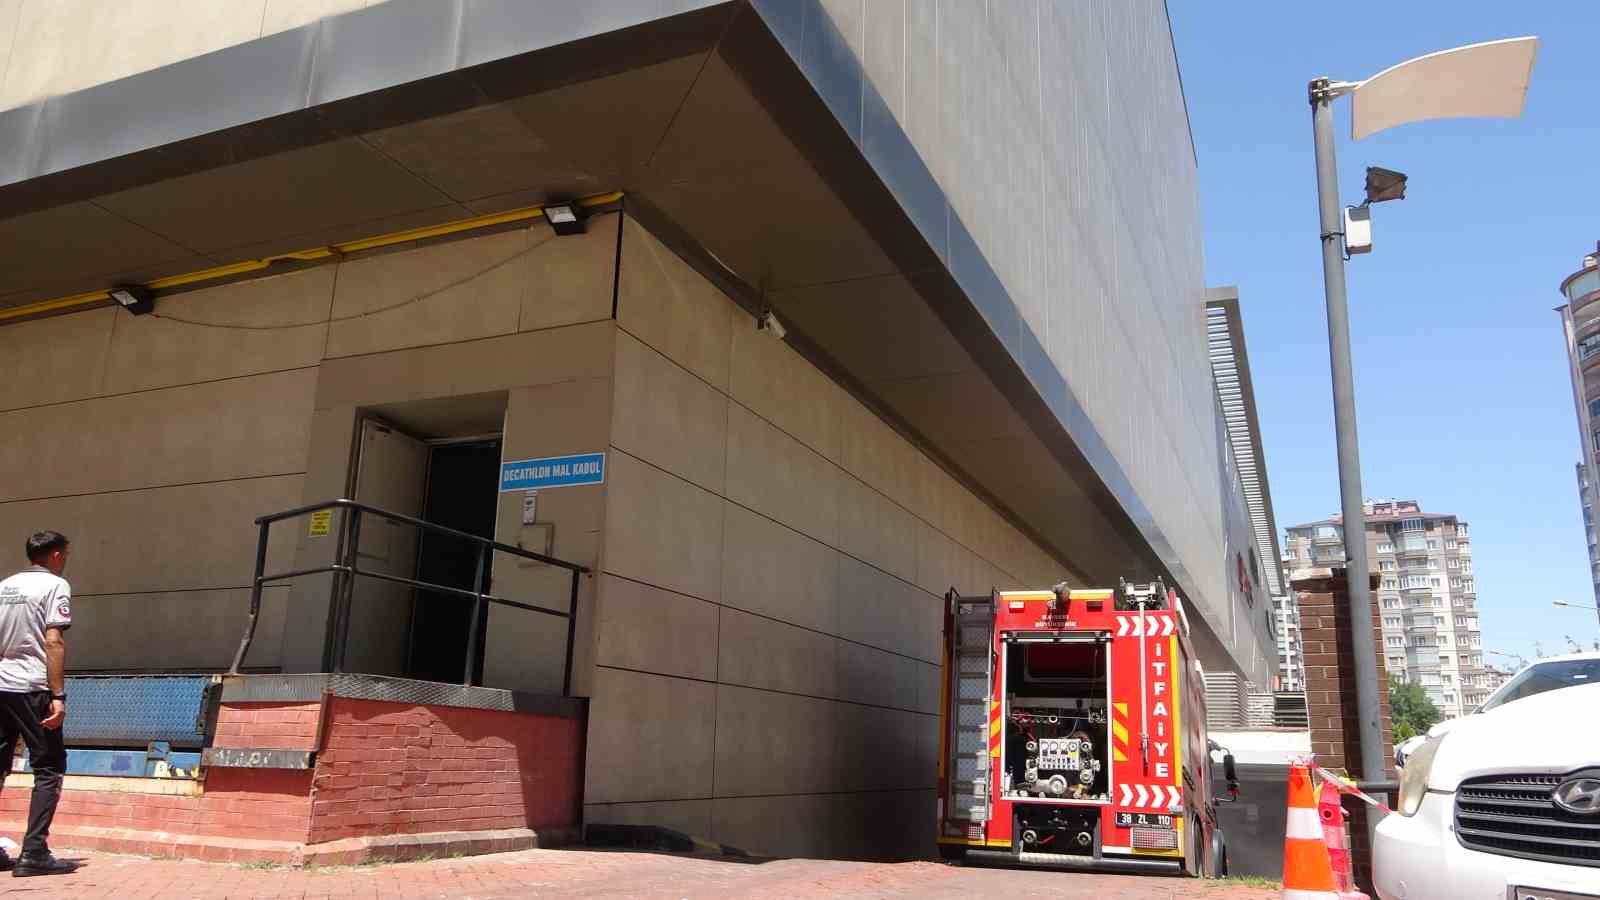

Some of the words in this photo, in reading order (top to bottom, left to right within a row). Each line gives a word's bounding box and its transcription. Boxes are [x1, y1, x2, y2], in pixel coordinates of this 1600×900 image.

[503, 465, 550, 481] DECATHLON
[553, 464, 571, 477] MAL
[573, 461, 600, 475] KABUL
[1138, 815, 1148, 825] ZL
[1157, 815, 1171, 825] 110
